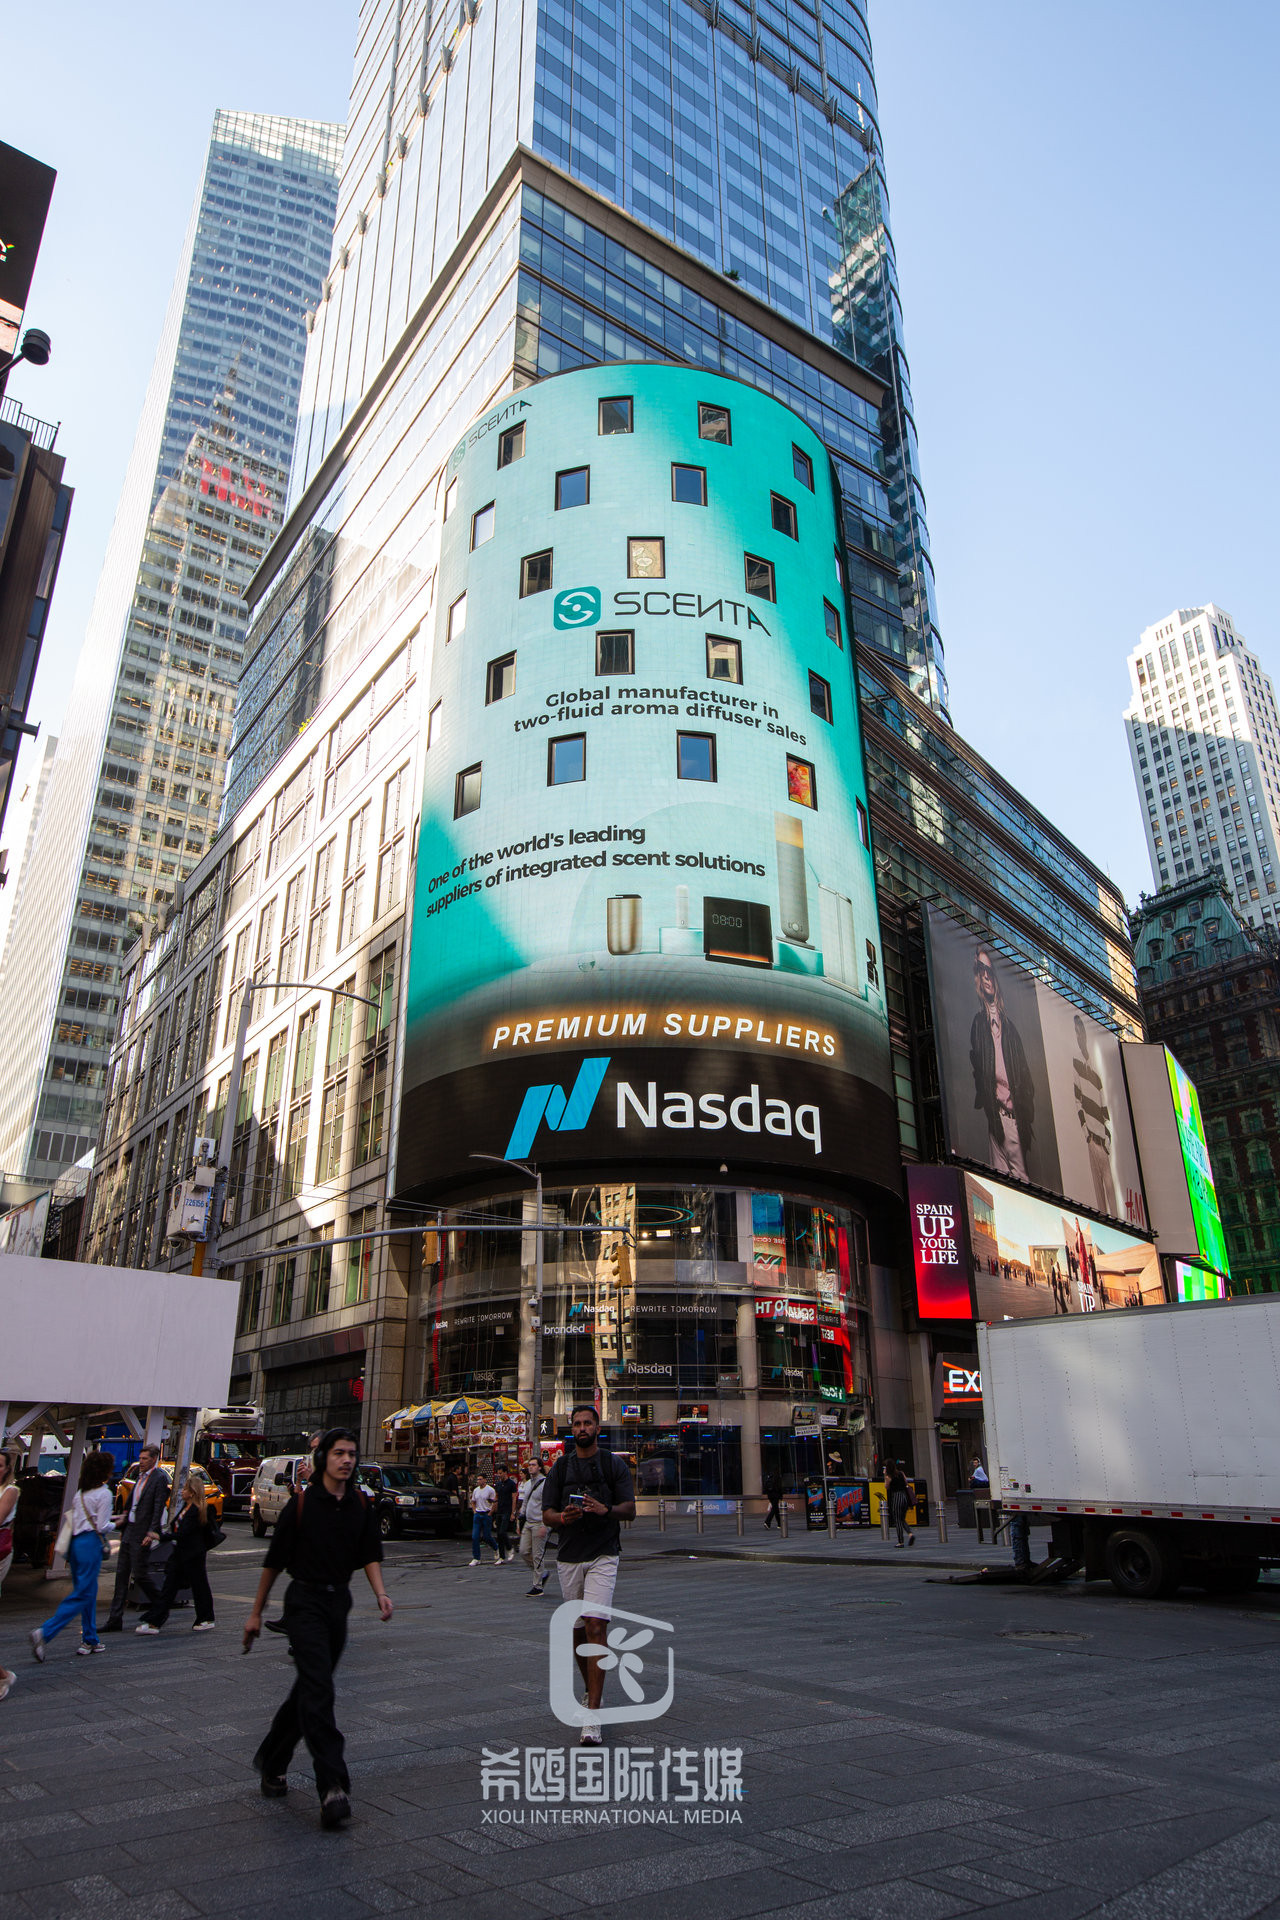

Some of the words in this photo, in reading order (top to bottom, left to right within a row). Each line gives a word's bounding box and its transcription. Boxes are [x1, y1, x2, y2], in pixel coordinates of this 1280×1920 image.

[613, 591, 771, 637] SCENTA
[545, 685, 610, 708] Global
[618, 685, 757, 712] manufacturer
[763, 700, 779, 719] in
[514, 702, 604, 733] two-fluid
[610, 701, 679, 716] aroma
[686, 700, 762, 729] diffuser
[766, 722, 807, 746] sales
[428, 869, 449, 894] One
[452, 859, 467, 879] of
[468, 849, 494, 872] the
[496, 832, 564, 860] world's
[569, 825, 646, 848] leading
[426, 880, 482, 918] suppliers
[485, 869, 504, 888] of
[505, 851, 606, 884] integrated
[612, 851, 670, 867] scent
[675, 851, 766, 877] solutions
[492, 1013, 647, 1050] PREMIUM
[663, 1013, 836, 1056] SUPPLIERS
[616, 1081, 823, 1155] Nasdaq
[916, 1204, 953, 1216] SPAIN
[917, 1216, 954, 1238] UP
[919, 1238, 957, 1249] YOUR
[920, 1250, 959, 1265] LIFE
[584, 1304, 615, 1314] Nasdaq
[670, 1305, 718, 1314] TOMORROW
[1079, 1293, 1095, 1312] UP
[628, 1363, 672, 1376] Nasdaq
[949, 1370, 983, 1392] EX
